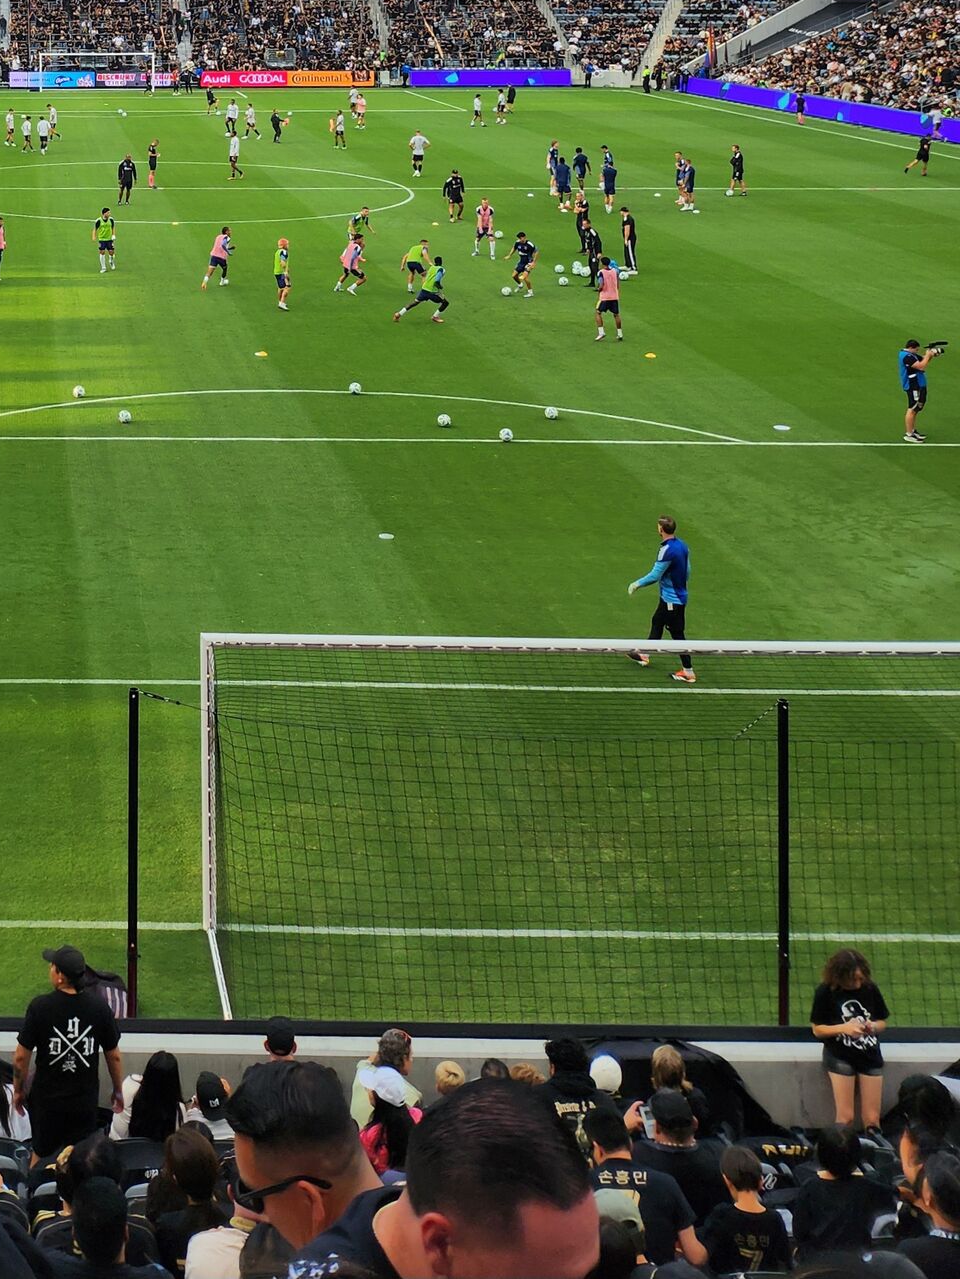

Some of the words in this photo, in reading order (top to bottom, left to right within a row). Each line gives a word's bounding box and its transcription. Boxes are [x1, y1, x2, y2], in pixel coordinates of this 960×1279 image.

[97, 73, 135, 81] DISCOUNT
[203, 74, 230, 83] Audi
[292, 74, 342, 84] Continental
[598, 1170, 647, 1185] 손흥민
